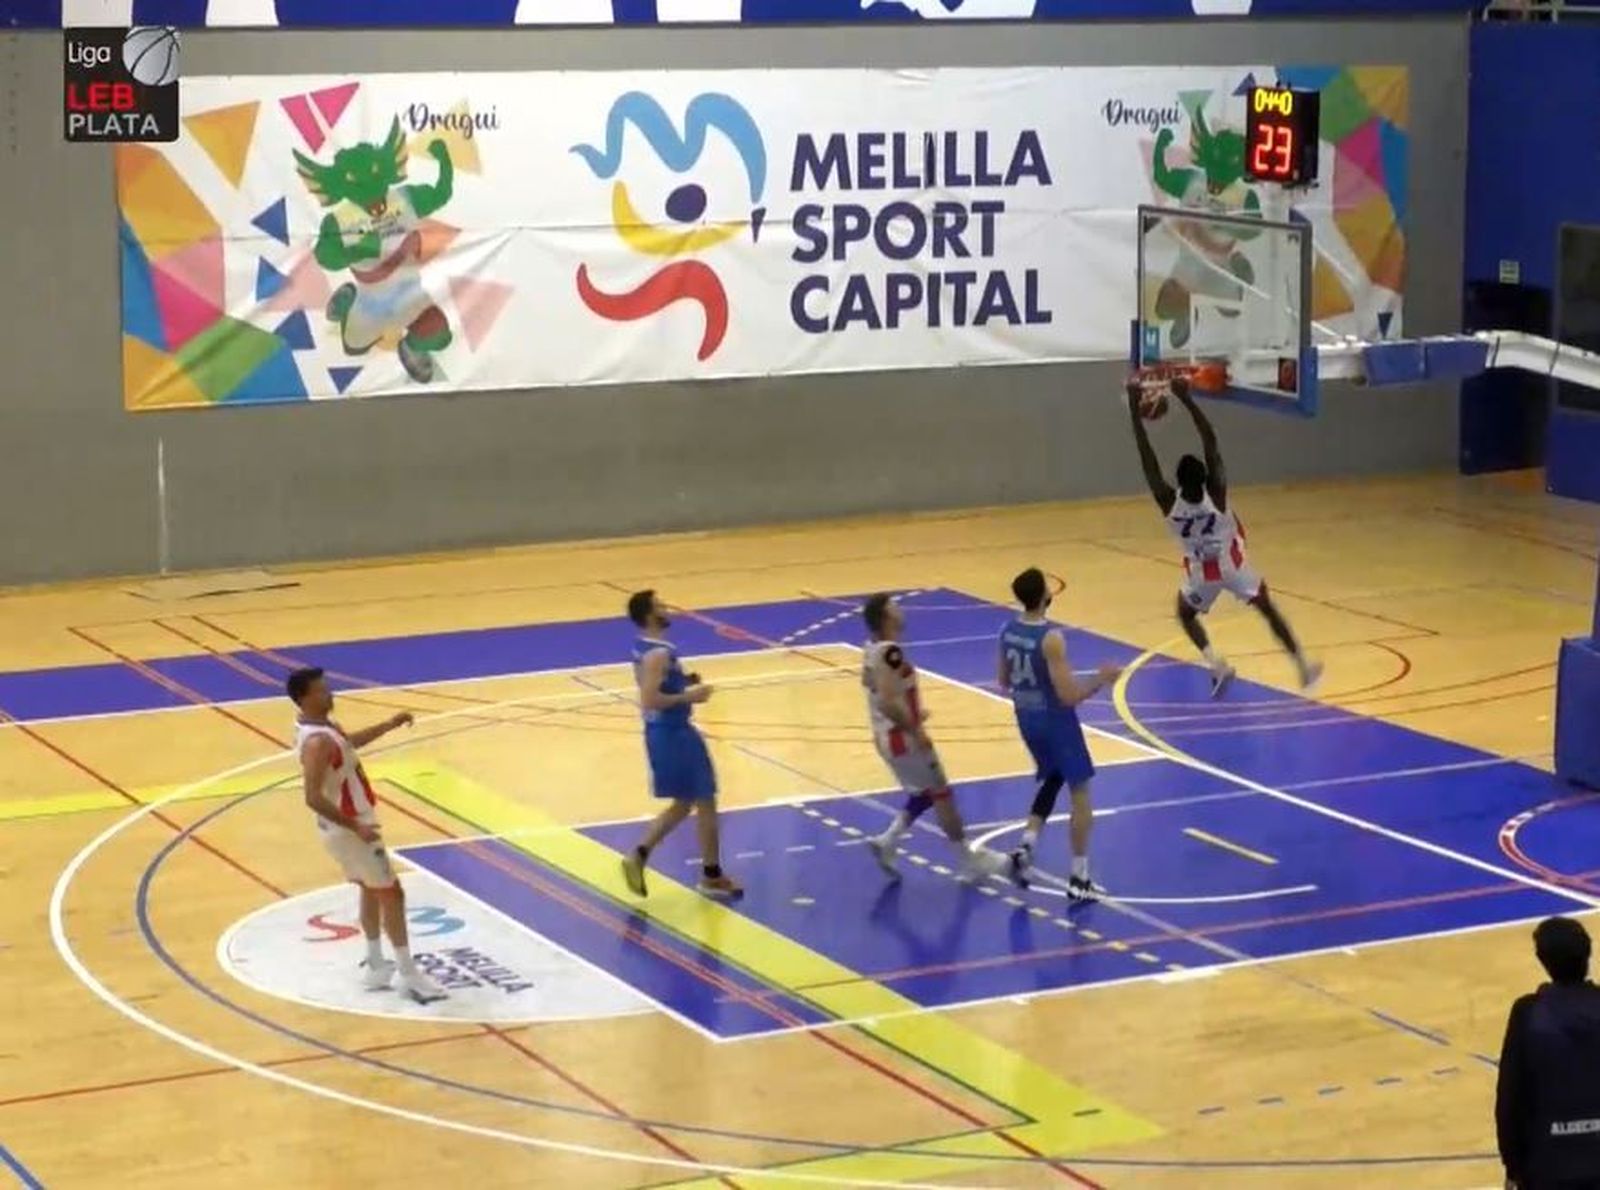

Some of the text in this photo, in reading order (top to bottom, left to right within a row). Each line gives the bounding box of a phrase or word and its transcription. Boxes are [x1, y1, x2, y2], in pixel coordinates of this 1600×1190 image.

[402, 102, 501, 140] Dragui
[1101, 98, 1181, 135] Dragui
[790, 130, 1053, 192] MELILLA
[1254, 123, 1293, 174] 23
[791, 200, 1006, 263] SPORT
[790, 269, 1053, 334] CAPITAL
[442, 947, 534, 993] MELILLA
